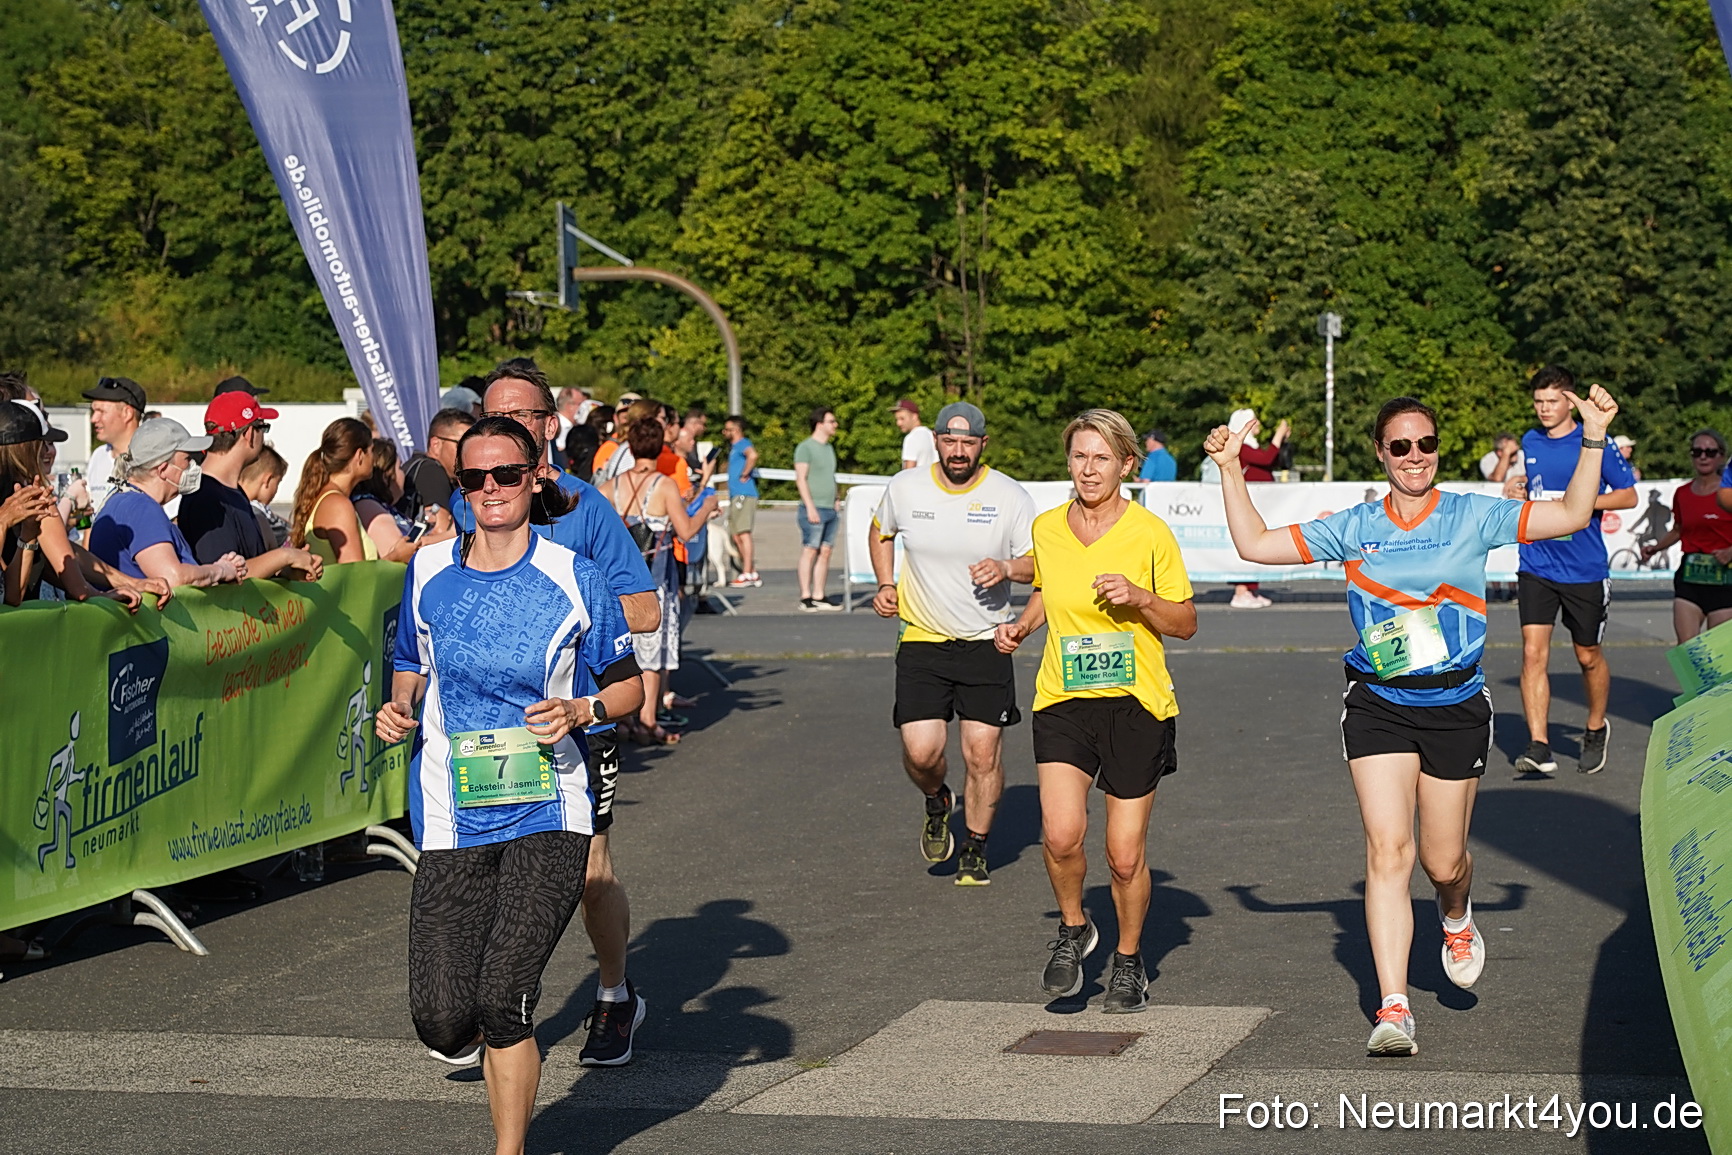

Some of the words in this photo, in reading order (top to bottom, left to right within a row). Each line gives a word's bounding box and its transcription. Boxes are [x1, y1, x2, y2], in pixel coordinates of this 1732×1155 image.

[1168, 503, 1203, 516] NOW
[1383, 545, 1416, 553] Neumarkt
[1384, 538, 1433, 547] Raiffeisenbank
[206, 607, 262, 666] Gesunde
[259, 599, 307, 639] Firmen
[1065, 660, 1074, 680] RUN
[1074, 651, 1124, 672] 1292
[1124, 652, 1133, 679] 2022
[1382, 655, 1408, 669] Semmler
[222, 655, 262, 704] laufen
[1080, 672, 1101, 681] Neger
[1102, 670, 1119, 679] Rosi
[121, 676, 156, 705] Fischer
[475, 742, 507, 752] Firmenlauf
[82, 712, 204, 829] firmenlauf
[459, 766, 470, 793] RUN
[493, 754, 510, 780] 7
[538, 755, 551, 790] 2022
[468, 781, 506, 793] Eckstein
[507, 778, 541, 790] Jasmin
[597, 759, 618, 816] NIKE
[83, 812, 140, 858] neumarkt
[168, 794, 313, 863] www.firmenlauf-oberpfalz.de
